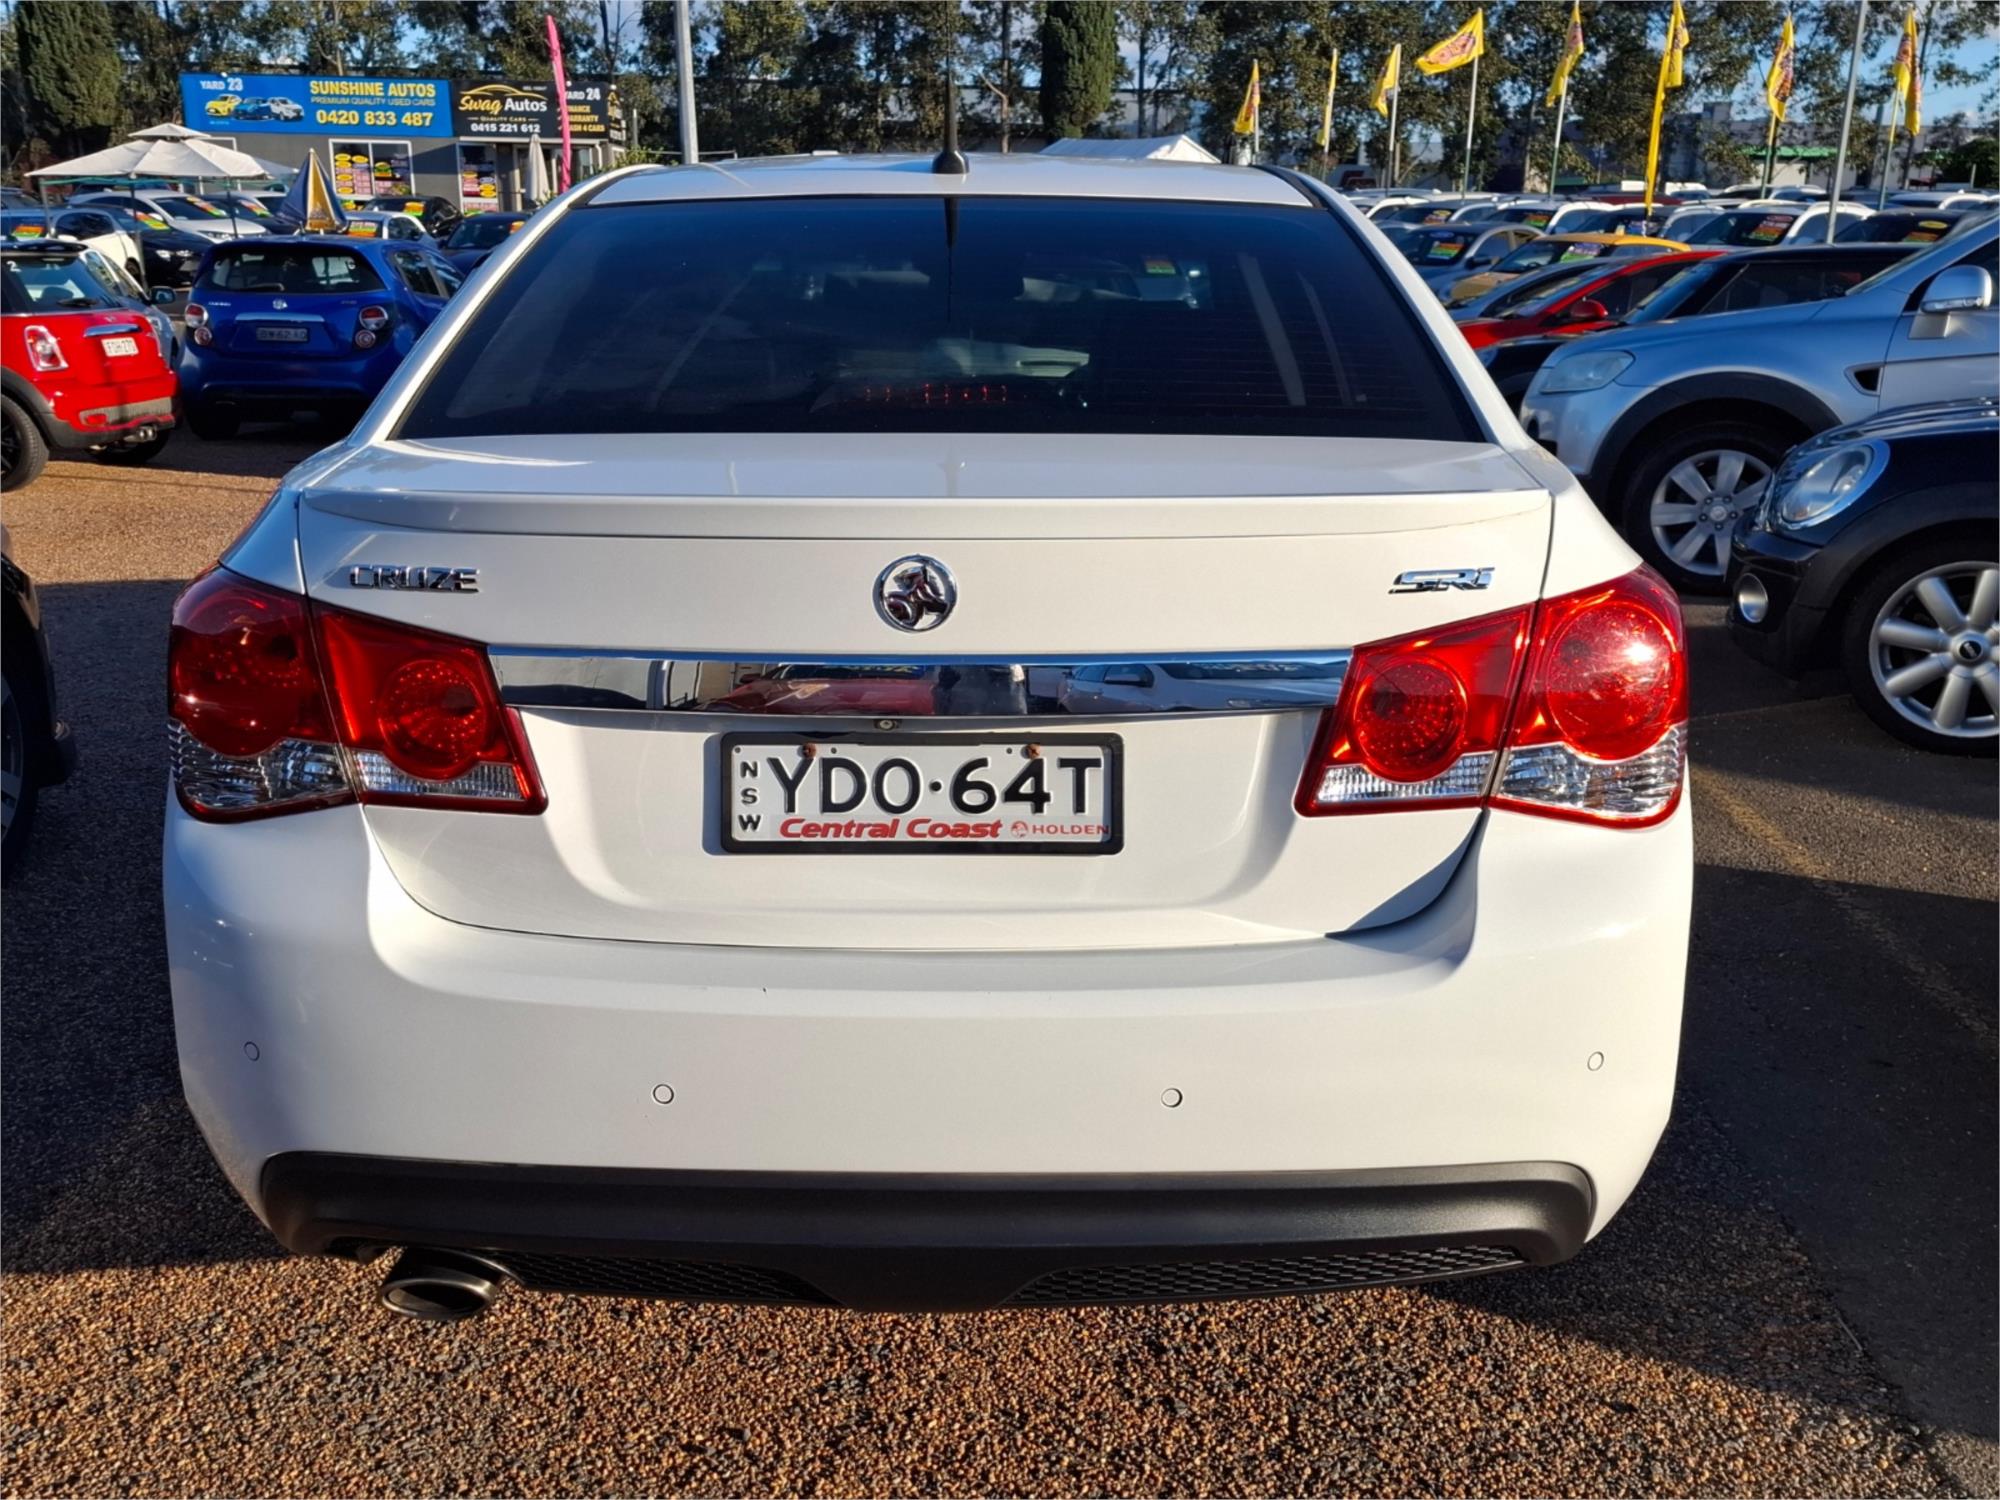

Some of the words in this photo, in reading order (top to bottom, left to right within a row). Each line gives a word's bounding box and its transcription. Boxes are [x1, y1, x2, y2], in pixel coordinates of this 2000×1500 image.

[200, 80, 225, 90] YARD
[227, 77, 243, 91] 23
[310, 80, 384, 96] SUNSHINE
[388, 82, 436, 98] AUTOS
[311, 96, 349, 105] PREMIUM
[351, 97, 386, 106] QUALITY
[388, 98, 411, 106] USED
[412, 98, 436, 106] CARS
[586, 87, 601, 100] 24
[458, 95, 502, 115] Swag
[504, 97, 548, 112] Autos
[316, 109, 359, 125] 0420
[364, 111, 397, 126] 833
[401, 111, 434, 126] 487
[470, 122, 497, 132] 0415
[499, 122, 518, 133] 221
[521, 123, 541, 133] 612
[349, 564, 481, 594] CRUZE
[779, 818, 900, 838] Central
[906, 818, 1003, 838] Coast
[1032, 824, 1109, 835] HOLDEN
